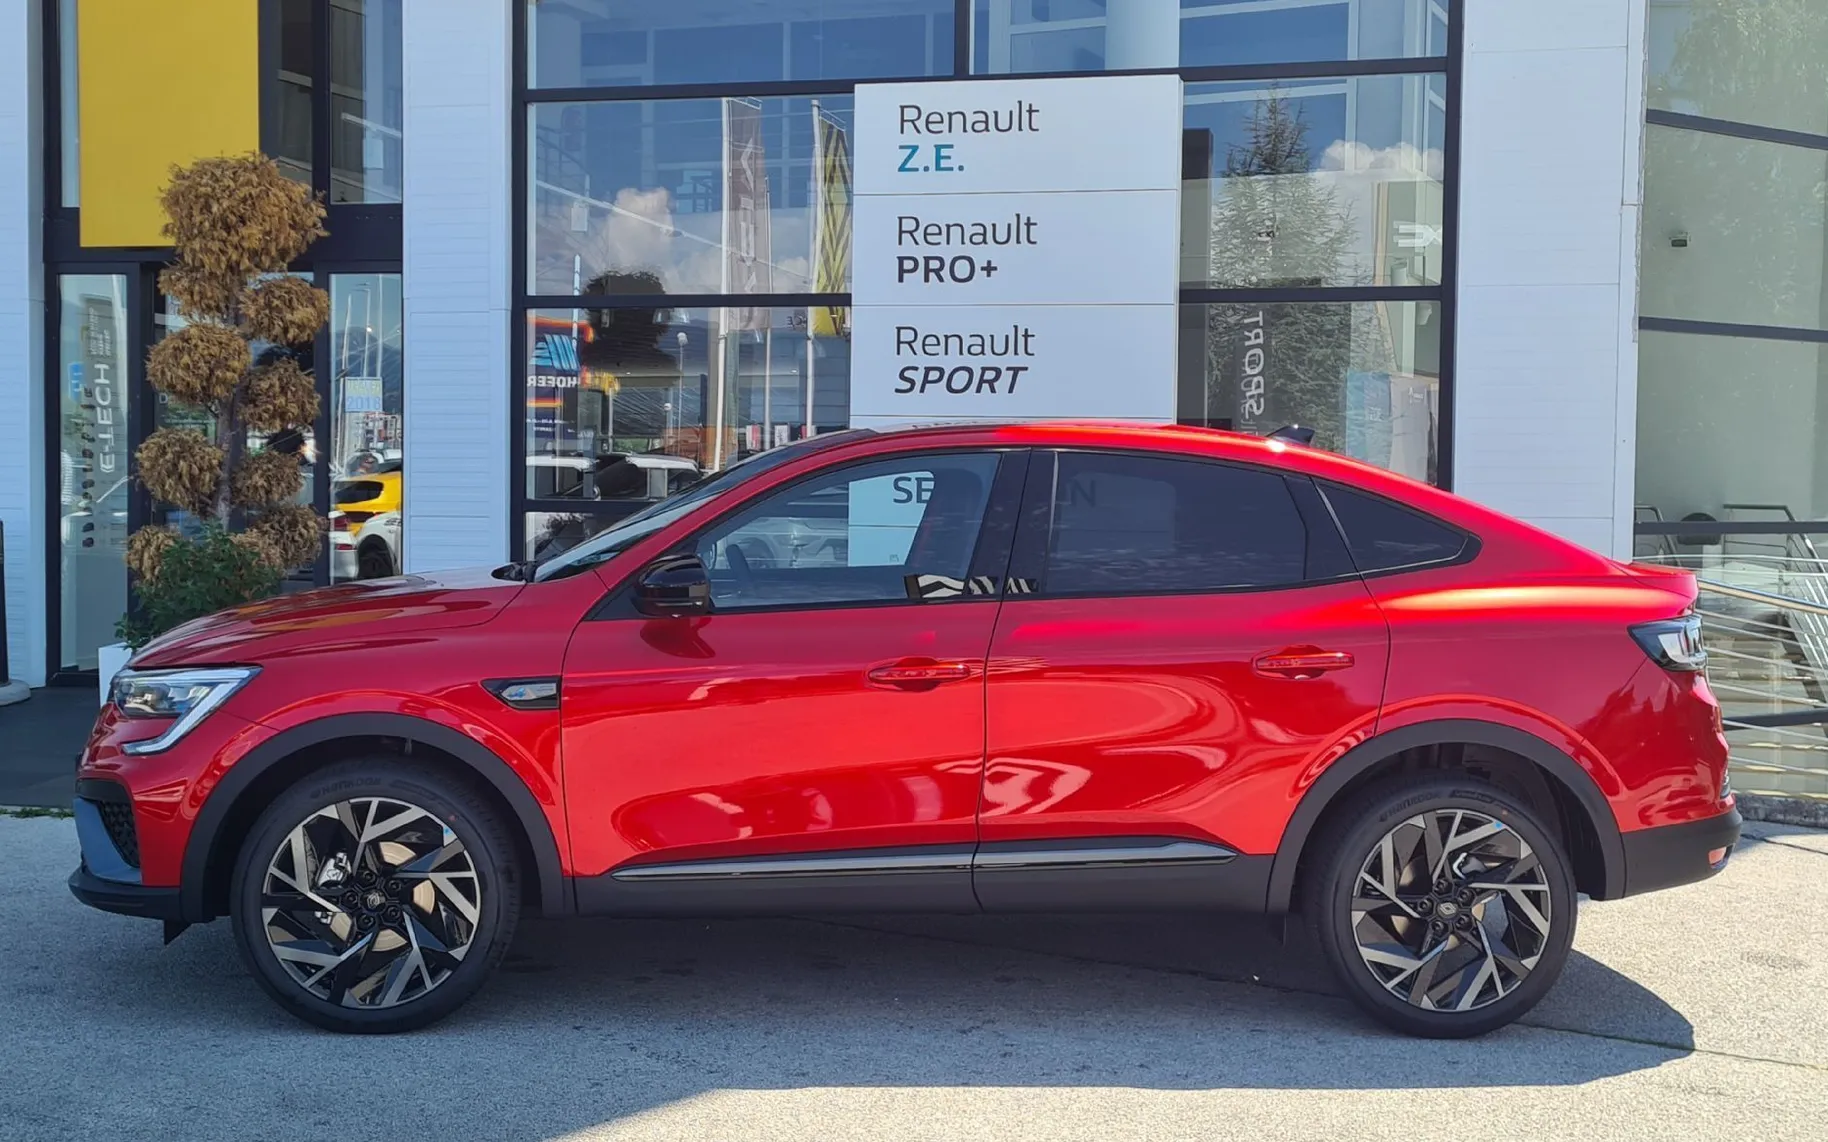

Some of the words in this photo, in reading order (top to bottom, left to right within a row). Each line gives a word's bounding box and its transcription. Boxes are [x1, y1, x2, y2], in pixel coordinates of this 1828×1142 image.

[899, 100, 1040, 134] Renault
[897, 144, 965, 173] Z.E.
[897, 213, 1038, 246] Renault
[896, 255, 998, 283] PRO+
[895, 325, 1036, 357] Renault
[894, 366, 1029, 395] SPORT
